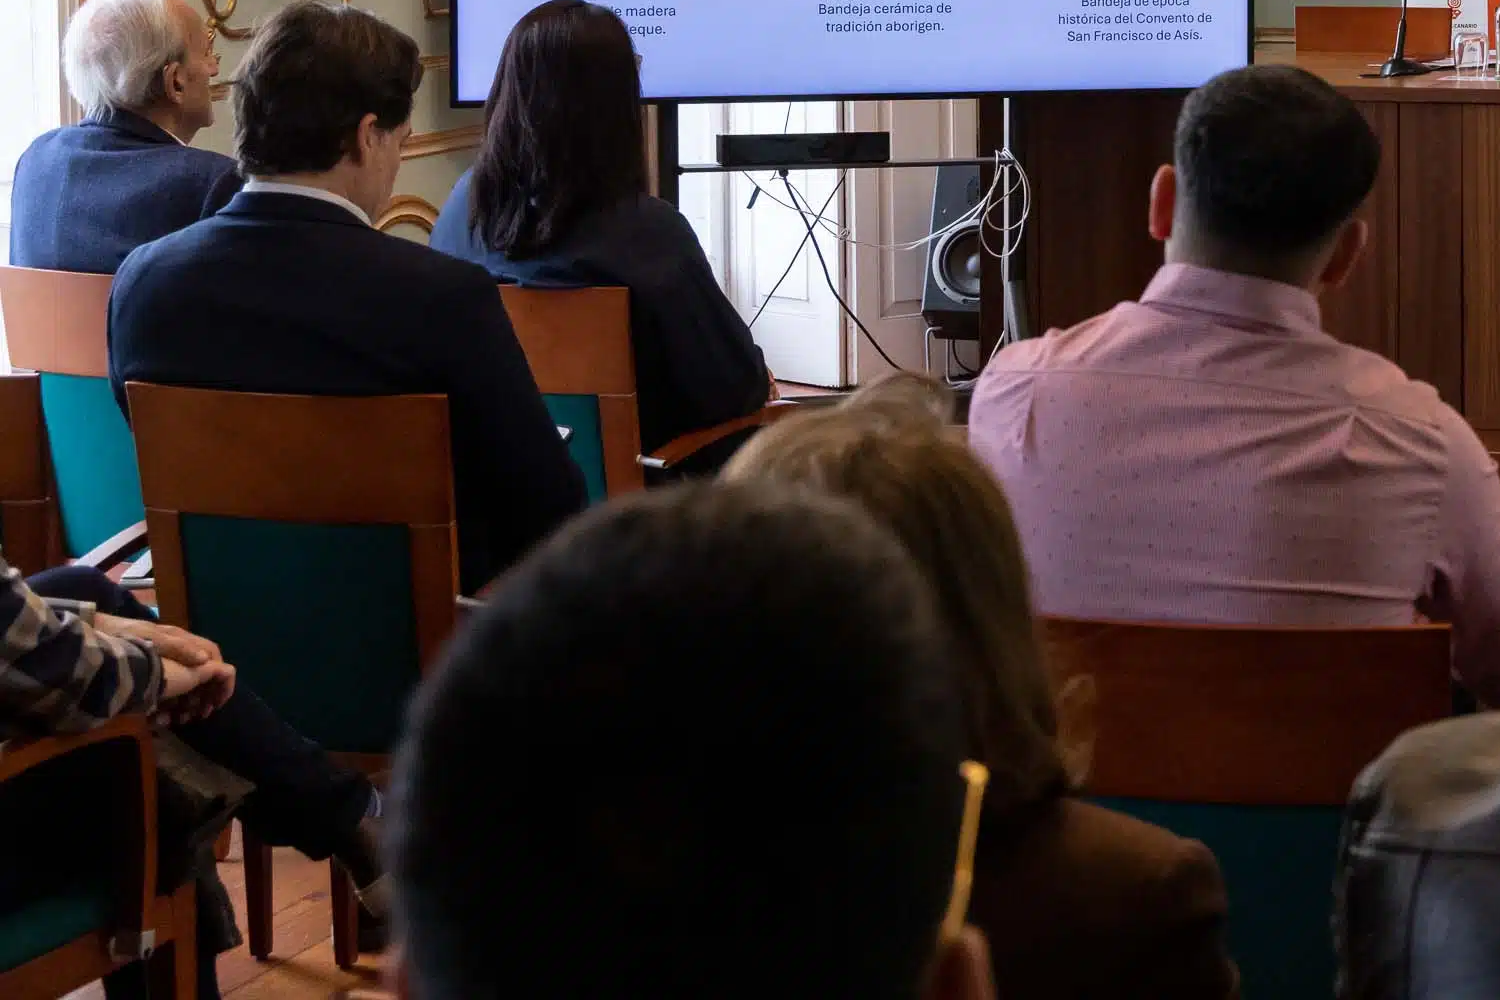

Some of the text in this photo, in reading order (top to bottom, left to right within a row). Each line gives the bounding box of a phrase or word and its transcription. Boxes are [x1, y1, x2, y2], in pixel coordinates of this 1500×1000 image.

[625, 5, 676, 17] madera
[818, 2, 952, 17] Bandeja cerámica de
[1058, 11, 1213, 26] histórica del Convento de
[825, 19, 945, 35] tradición aborigen.
[1067, 28, 1203, 42] San Francisco de Asís.
